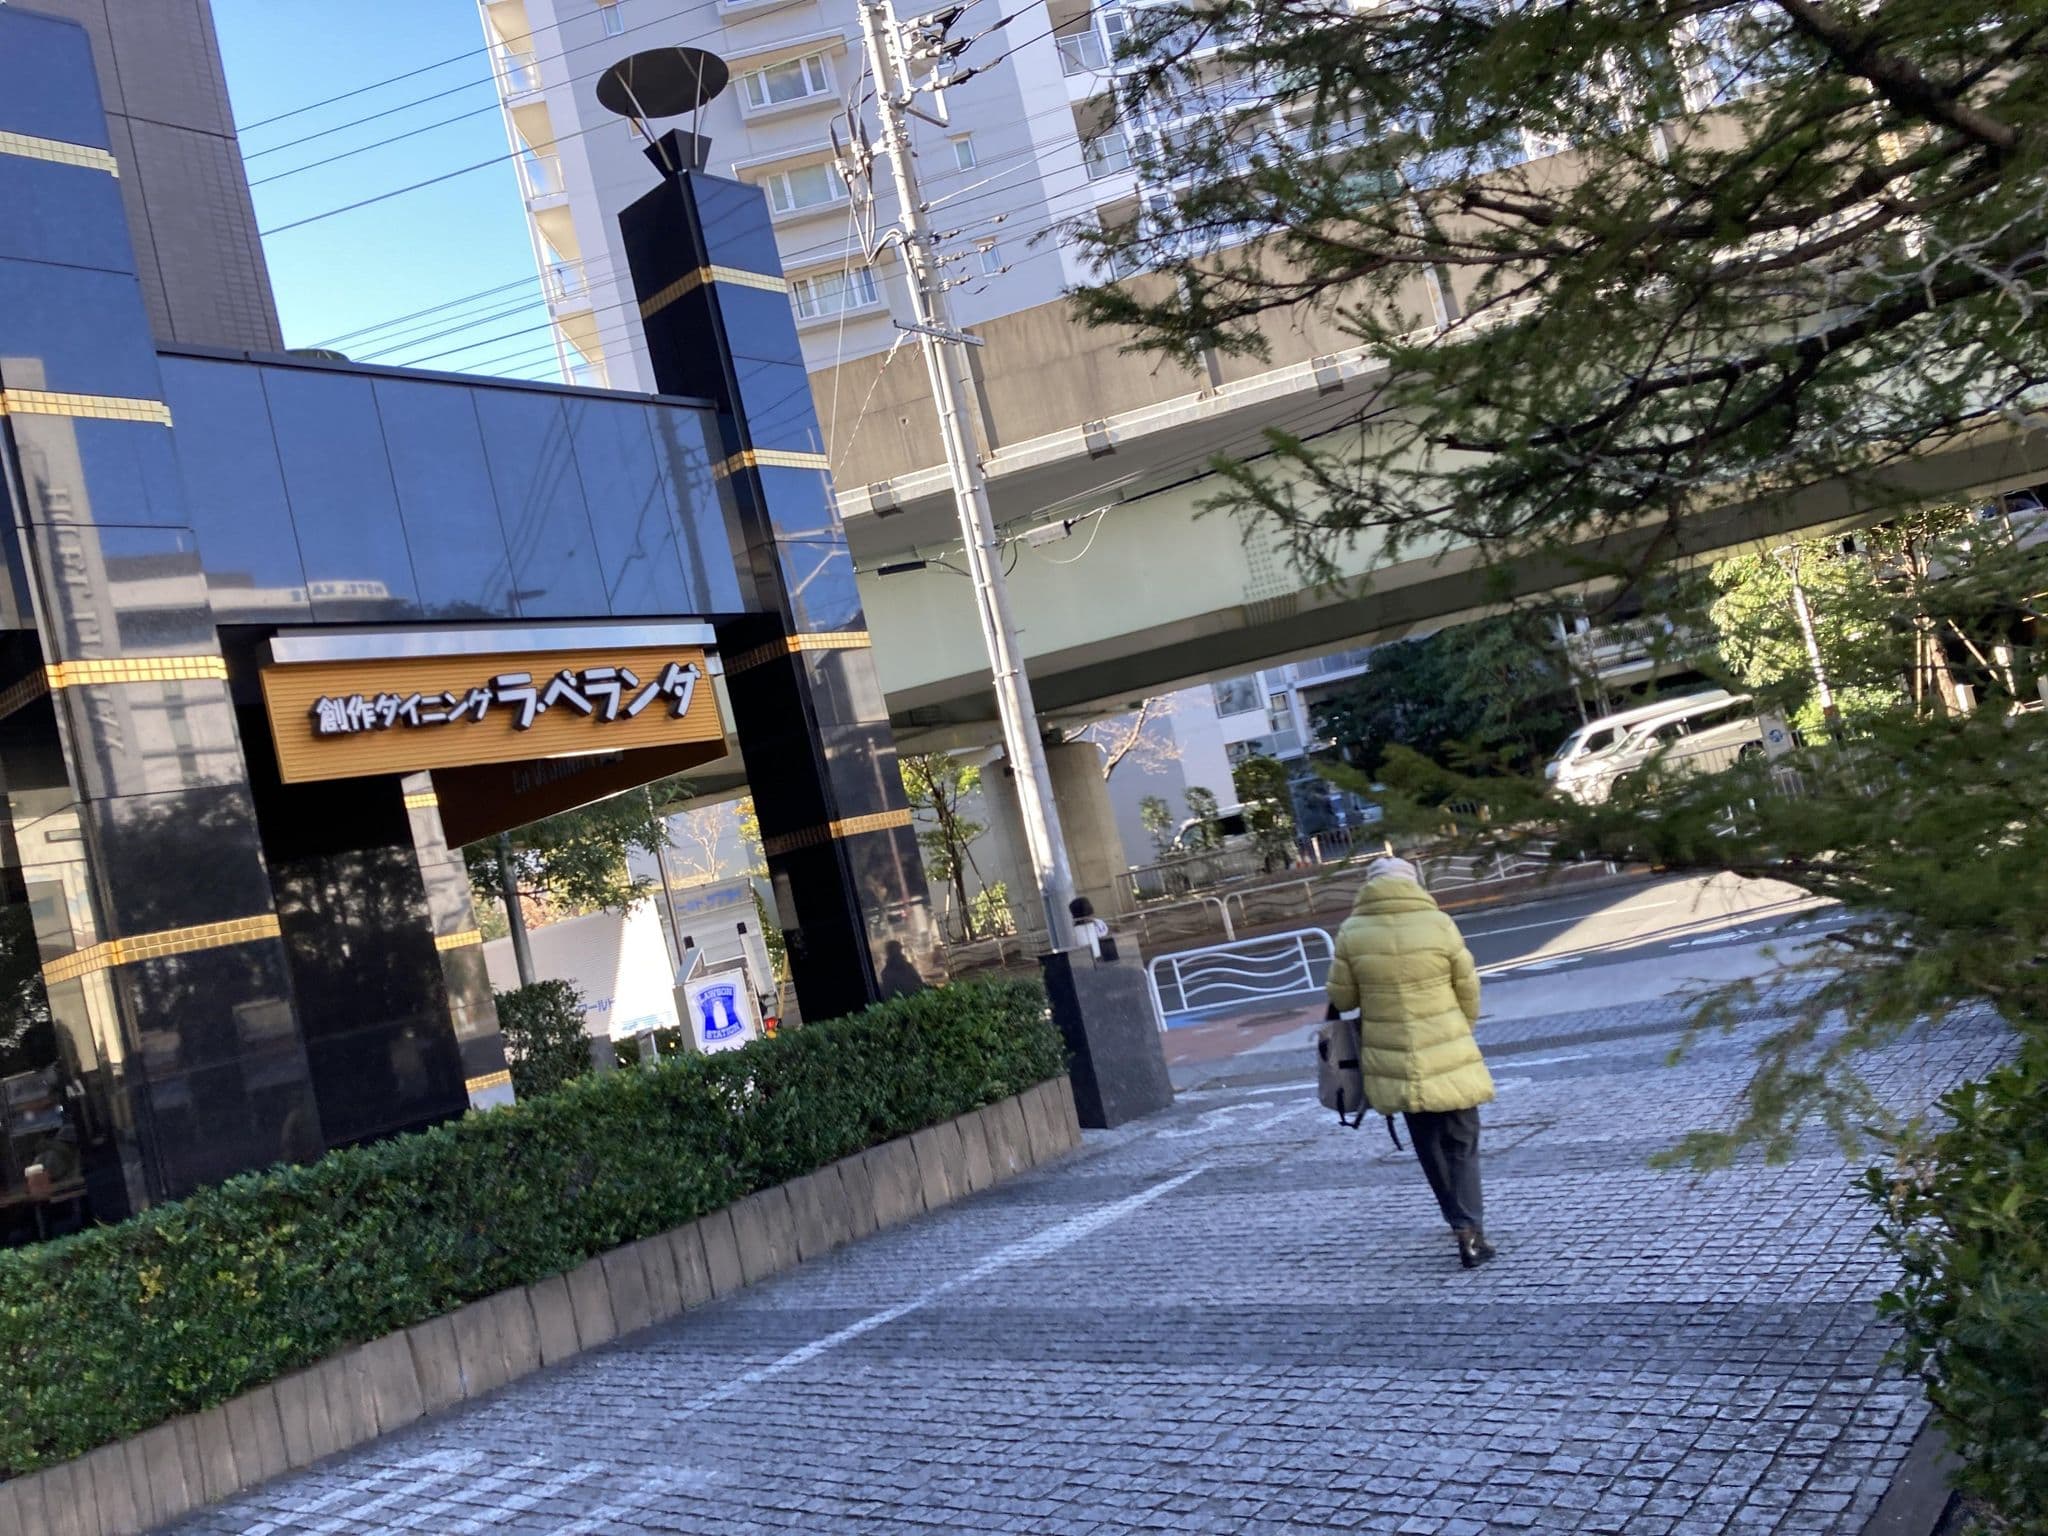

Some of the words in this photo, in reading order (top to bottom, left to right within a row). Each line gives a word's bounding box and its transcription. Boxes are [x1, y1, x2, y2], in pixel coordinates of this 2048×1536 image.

[312, 687, 493, 735] 創作ダイニング
